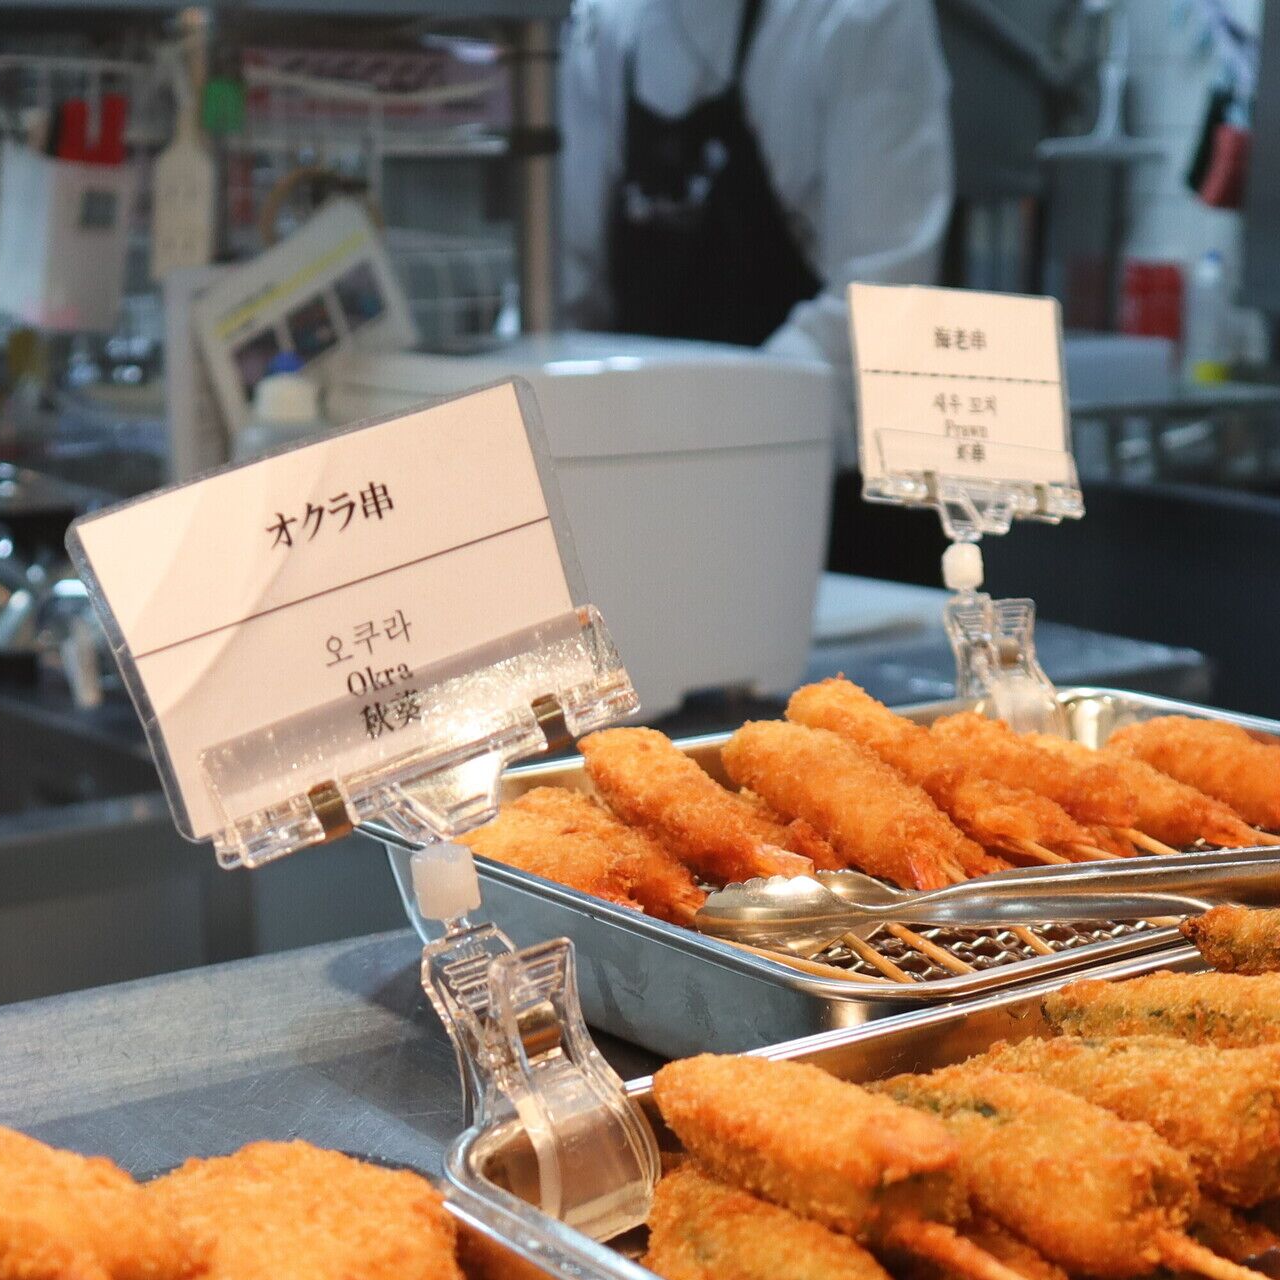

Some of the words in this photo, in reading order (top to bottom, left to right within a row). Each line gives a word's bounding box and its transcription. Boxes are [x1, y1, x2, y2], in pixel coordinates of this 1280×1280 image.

[933, 325, 987, 350] 海老串
[945, 419, 988, 438] Prawn
[265, 481, 394, 549] オクラ串
[326, 609, 412, 667] 오쿠라
[347, 662, 414, 696] Okra
[360, 689, 422, 740] 秋葵
